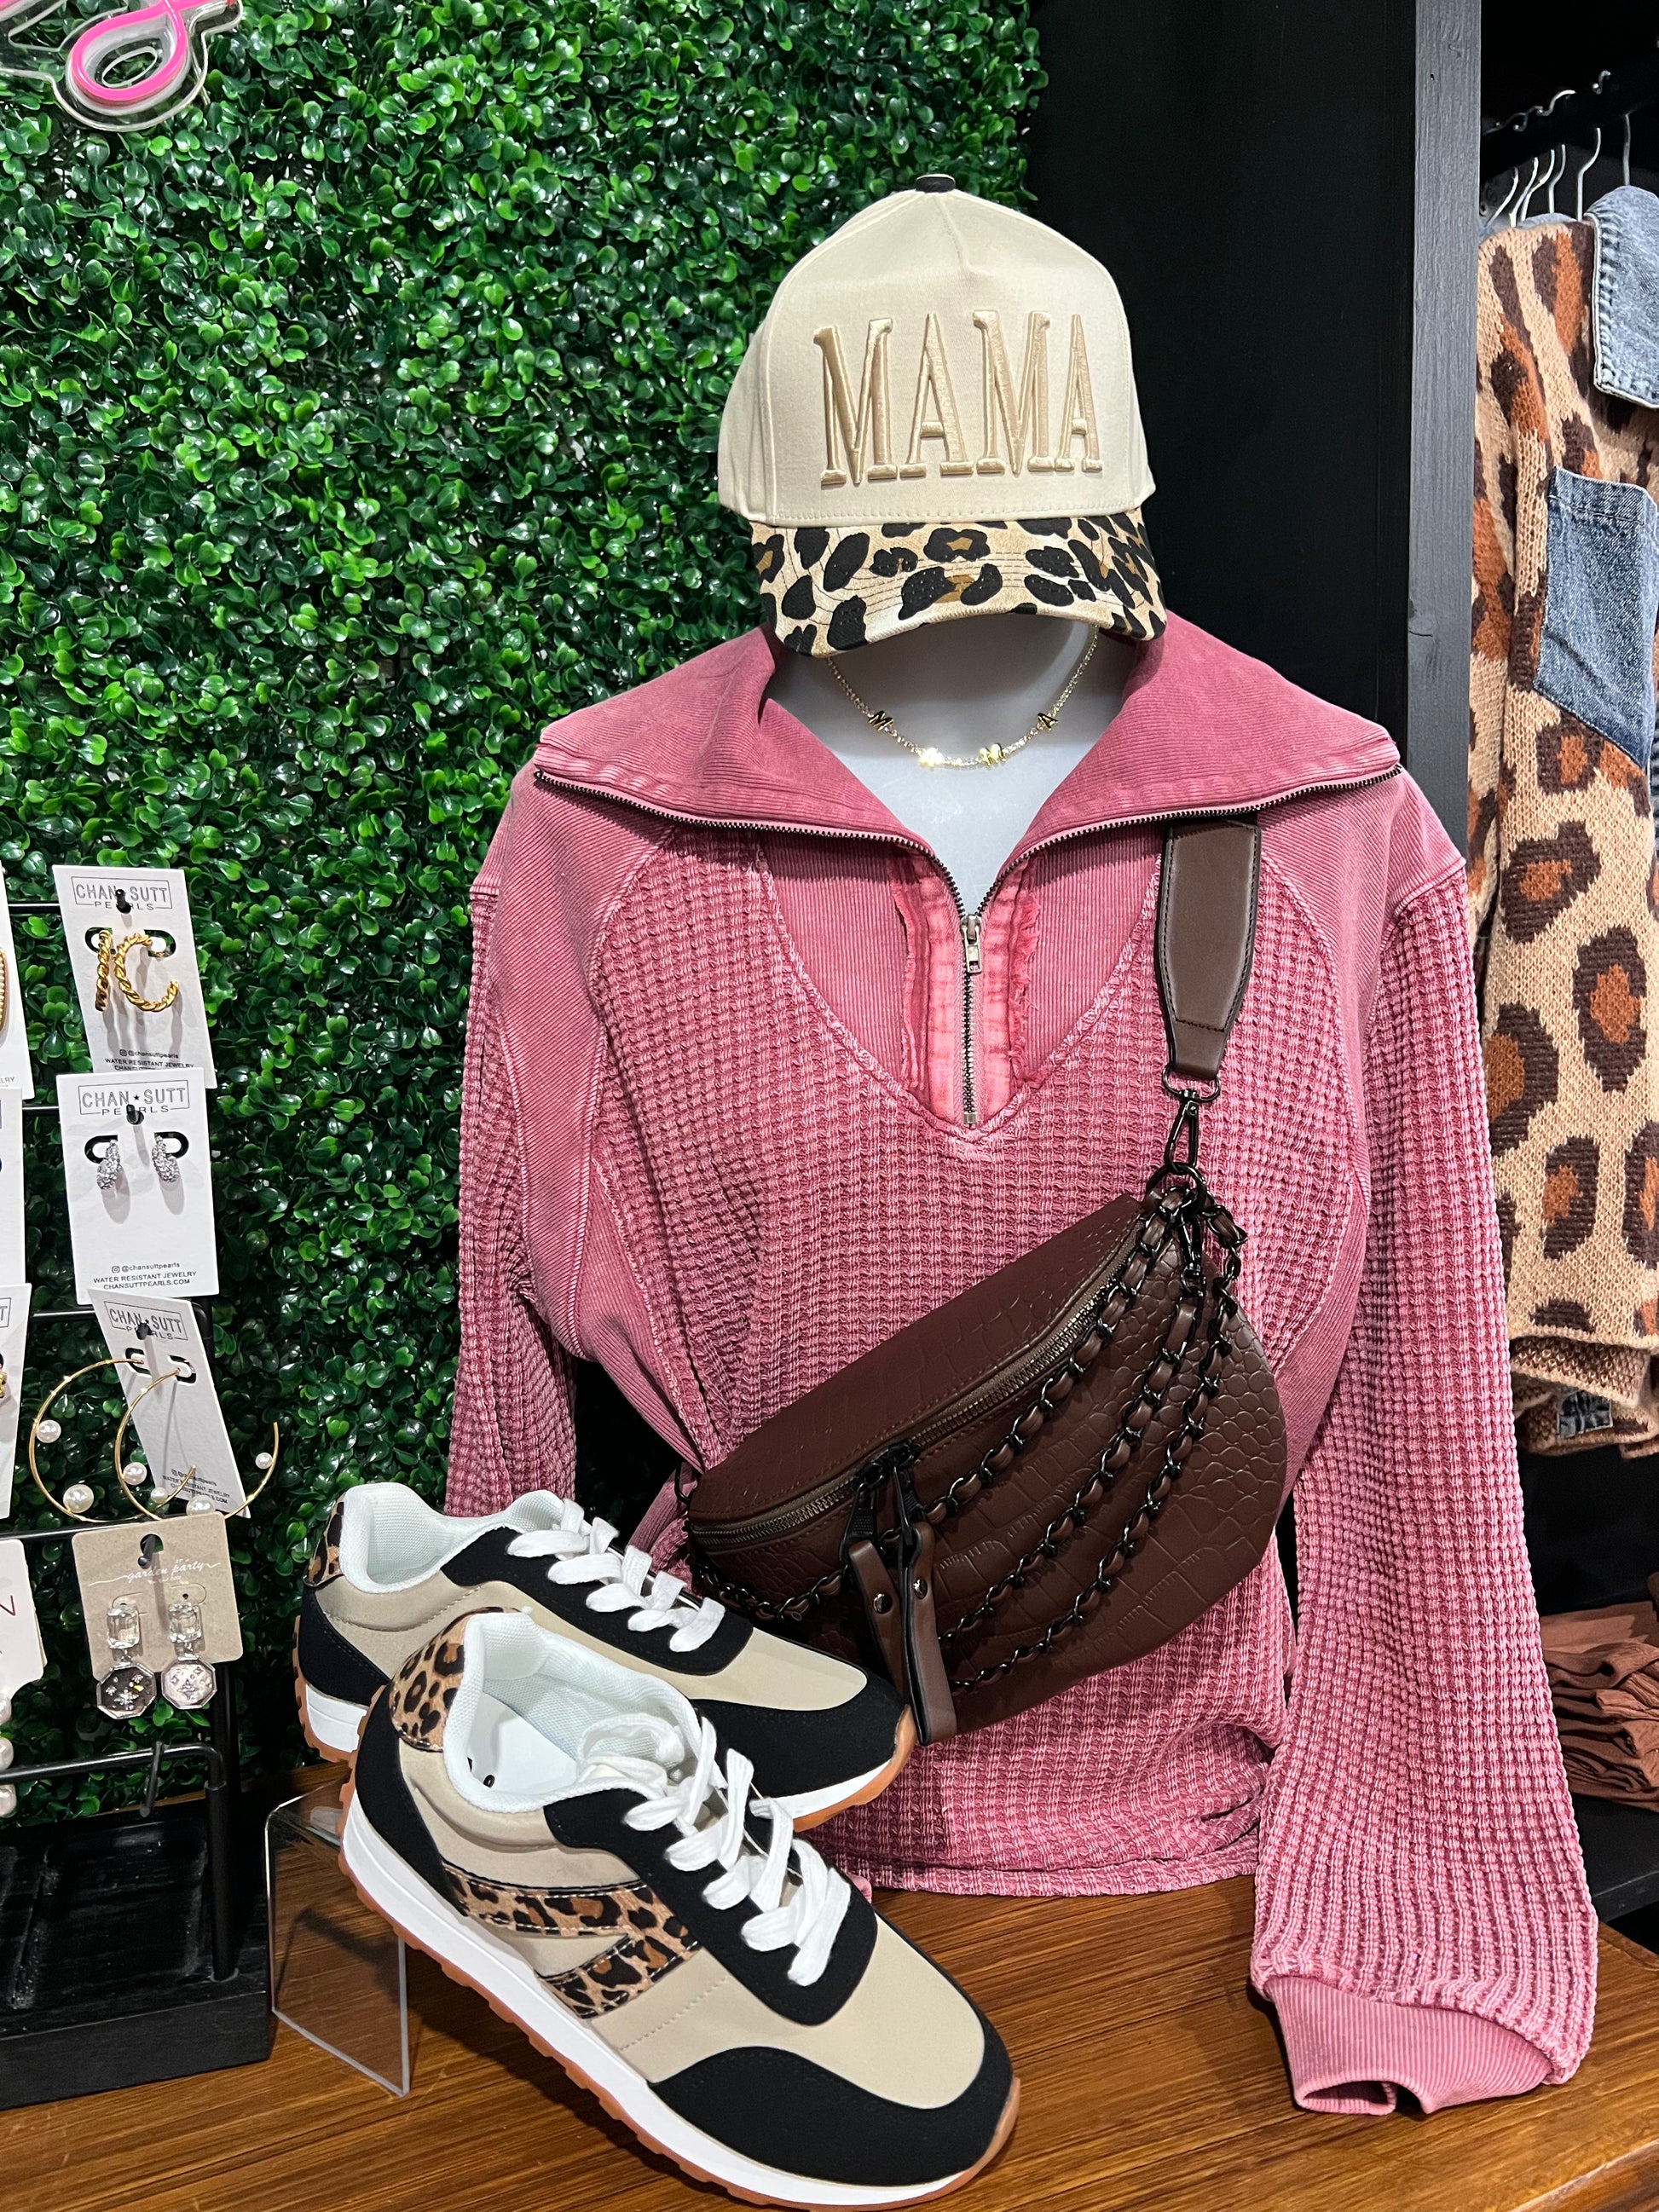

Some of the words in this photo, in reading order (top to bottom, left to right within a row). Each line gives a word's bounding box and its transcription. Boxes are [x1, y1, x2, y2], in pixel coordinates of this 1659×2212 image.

[812, 310, 1104, 488] MAMA
[76, 884, 117, 900] CHAN
[130, 886, 167, 902] SUTT
[95, 901, 154, 910] PERLS
[129, 1059, 163, 1067] RESISTANT
[82, 1090, 129, 1108] CHAN
[143, 1087, 186, 1105] SUTT
[102, 1105, 169, 1116] PERLS
[121, 1262, 181, 1273] @chansuttpearls
[121, 1273, 161, 1282] RESISTANT
[163, 1271, 197, 1279] JEWELRY
[103, 1279, 190, 1290] CHANSUTTPEARLS.COM
[109, 1308, 142, 1326] CHAN
[150, 1315, 182, 1333] SUTT
[128, 1565, 168, 1584] garden
[171, 1559, 205, 1575] party
